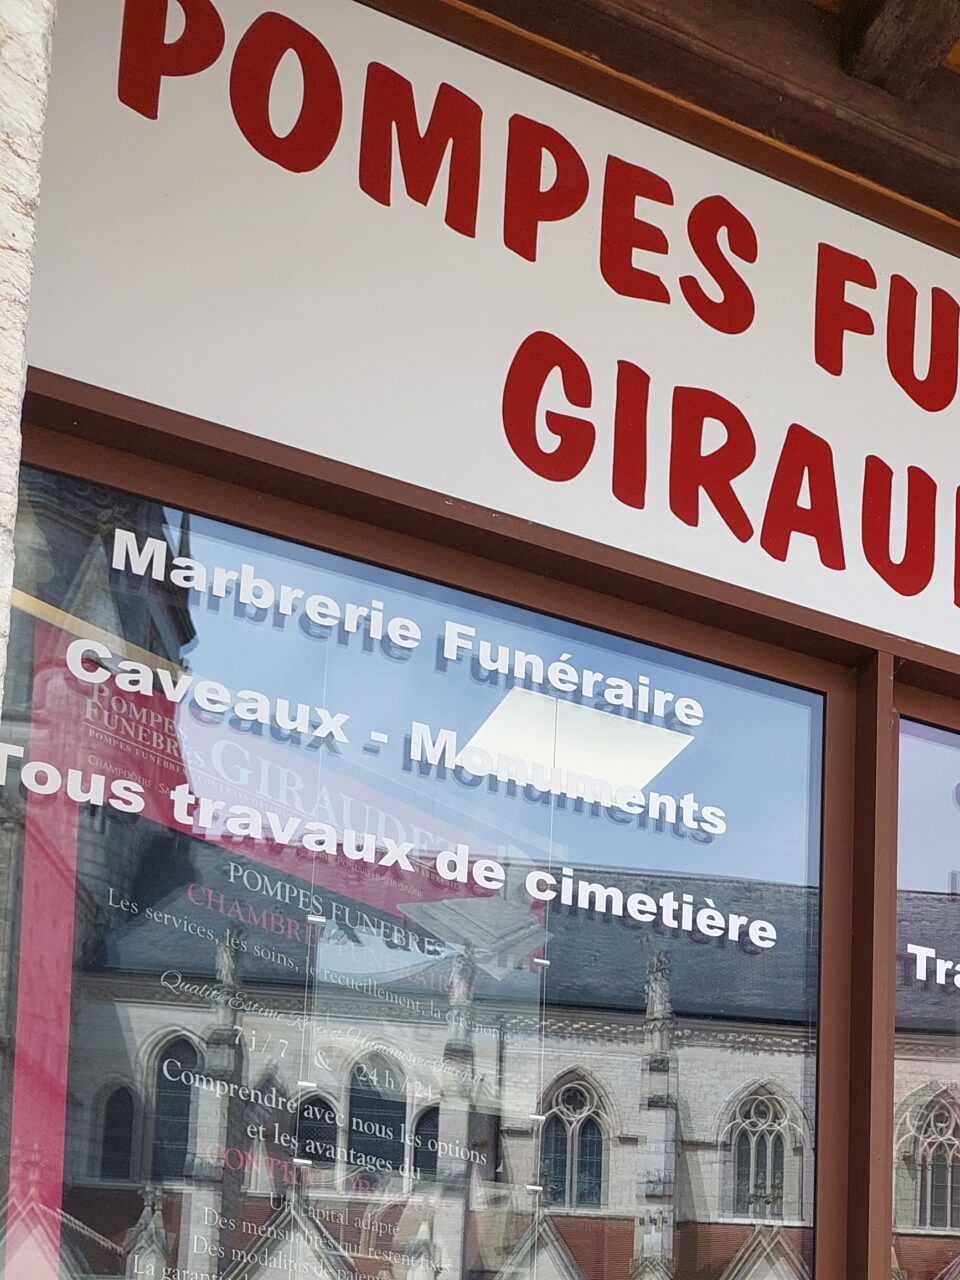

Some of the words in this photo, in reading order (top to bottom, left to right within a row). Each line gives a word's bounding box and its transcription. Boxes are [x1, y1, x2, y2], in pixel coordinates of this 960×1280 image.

[117, 0, 759, 336] POMPES
[110, 528, 423, 650] Marbrerie
[443, 620, 705, 727] Funéraire
[65, 638, 350, 745] Caveaux
[409, 720, 728, 836] Monuments
[92, 683, 188, 741] POMPES
[170, 785, 415, 871] travaux
[436, 842, 506, 892] de
[525, 866, 779, 950] cimetière
[227, 862, 324, 916] POMPES
[331, 901, 446, 961] FUNEBRES
[107, 887, 139, 915] Les
[145, 906, 220, 945] services,
[226, 928, 248, 952] les
[253, 943, 299, 972] soins,
[324, 967, 425, 1016] recueillement,
[430, 1000, 441, 1019] la
[162, 1058, 298, 1113] Comprendre
[303, 1103, 345, 1127] avec
[352, 1116, 394, 1140] nous
[400, 1123, 422, 1148] les
[427, 1138, 488, 1166] options
[358, 1063, 379, 1085] 24
[385, 1070, 395, 1090] h
[246, 1123, 267, 1142] et
[274, 1122, 299, 1150] les
[305, 1138, 393, 1175] avantages
[399, 1157, 421, 1180] du
[193, 1235, 225, 1258] Des
[203, 1206, 236, 1231] Des
[269, 1191, 293, 1212] Un
[301, 1203, 349, 1226] capital
[354, 1213, 401, 1238] adapté
[133, 1254, 155, 1276] La
